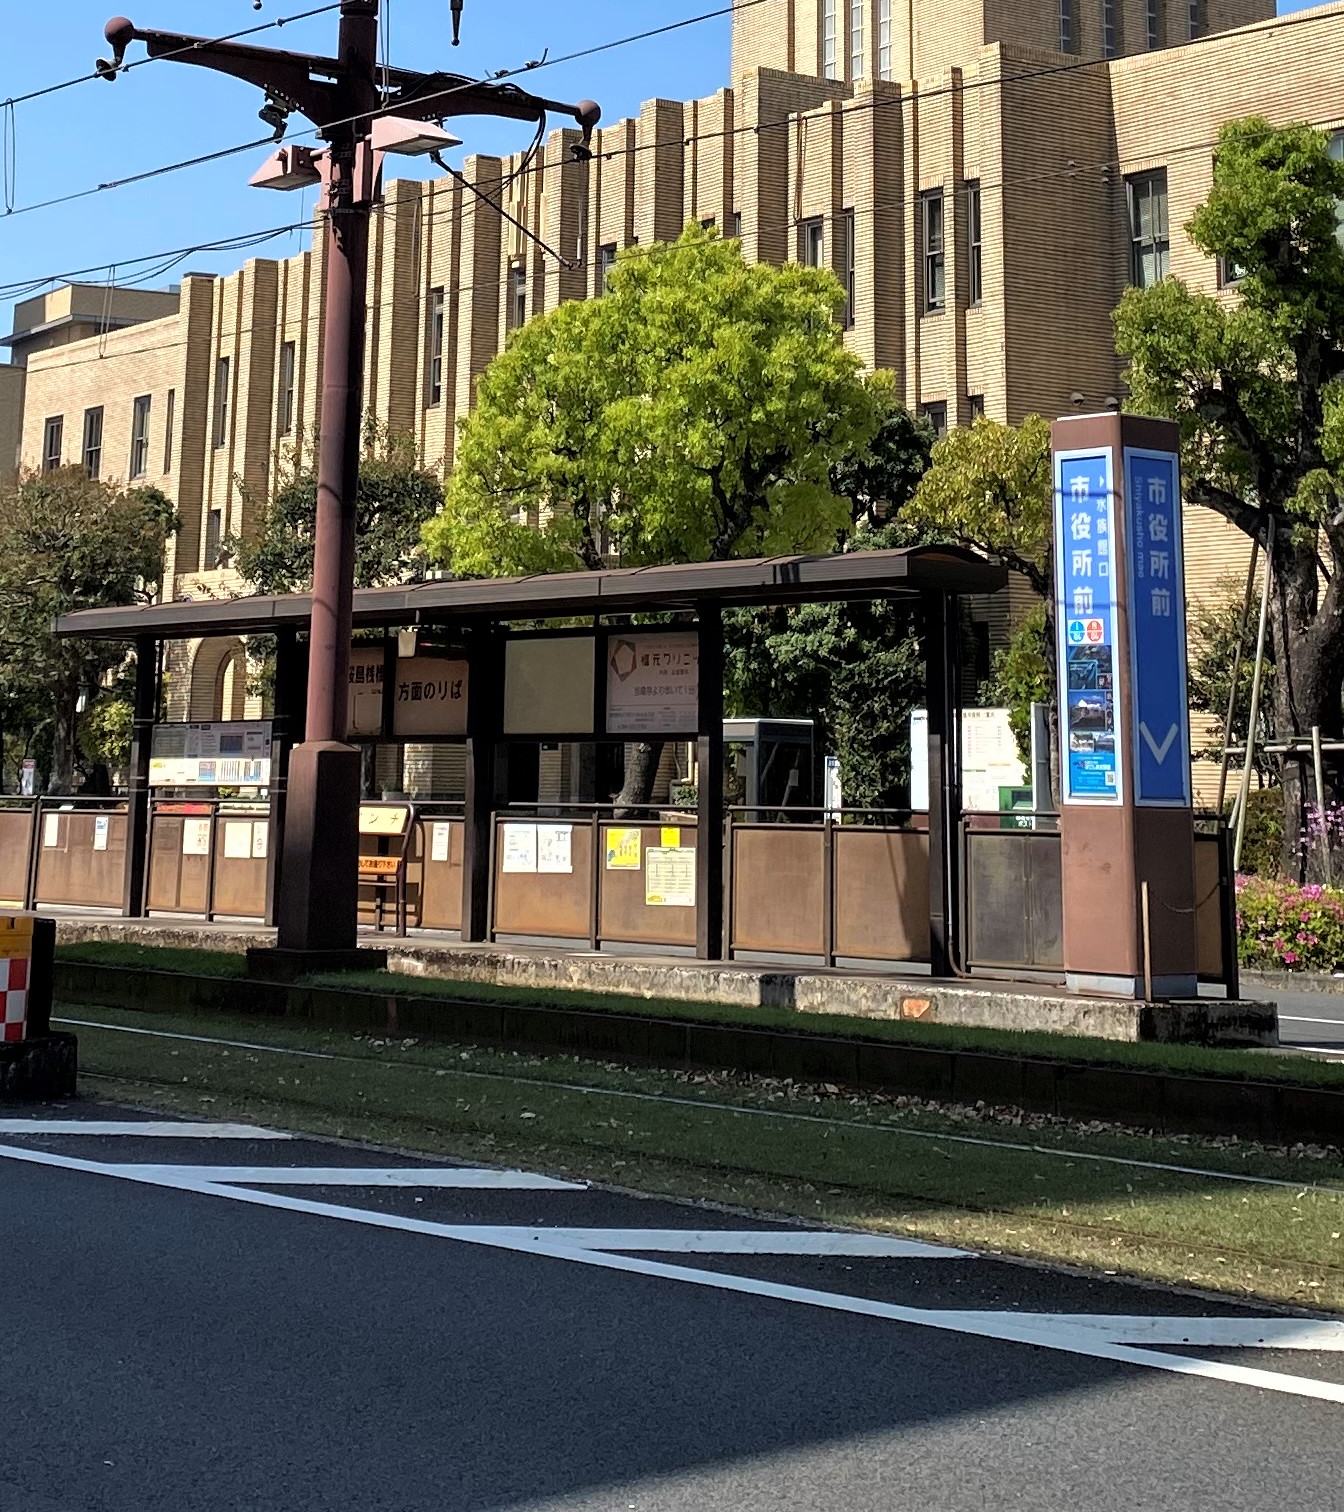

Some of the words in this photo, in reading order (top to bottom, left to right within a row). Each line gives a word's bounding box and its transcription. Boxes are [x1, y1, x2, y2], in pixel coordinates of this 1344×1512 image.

[1069, 475, 1094, 616] 市役所前
[1096, 497, 1109, 578] 水族館口
[1133, 475, 1146, 549] Shiyakusho
[1147, 476, 1172, 618] 市役所前
[398, 679, 464, 702] 方面のりば
